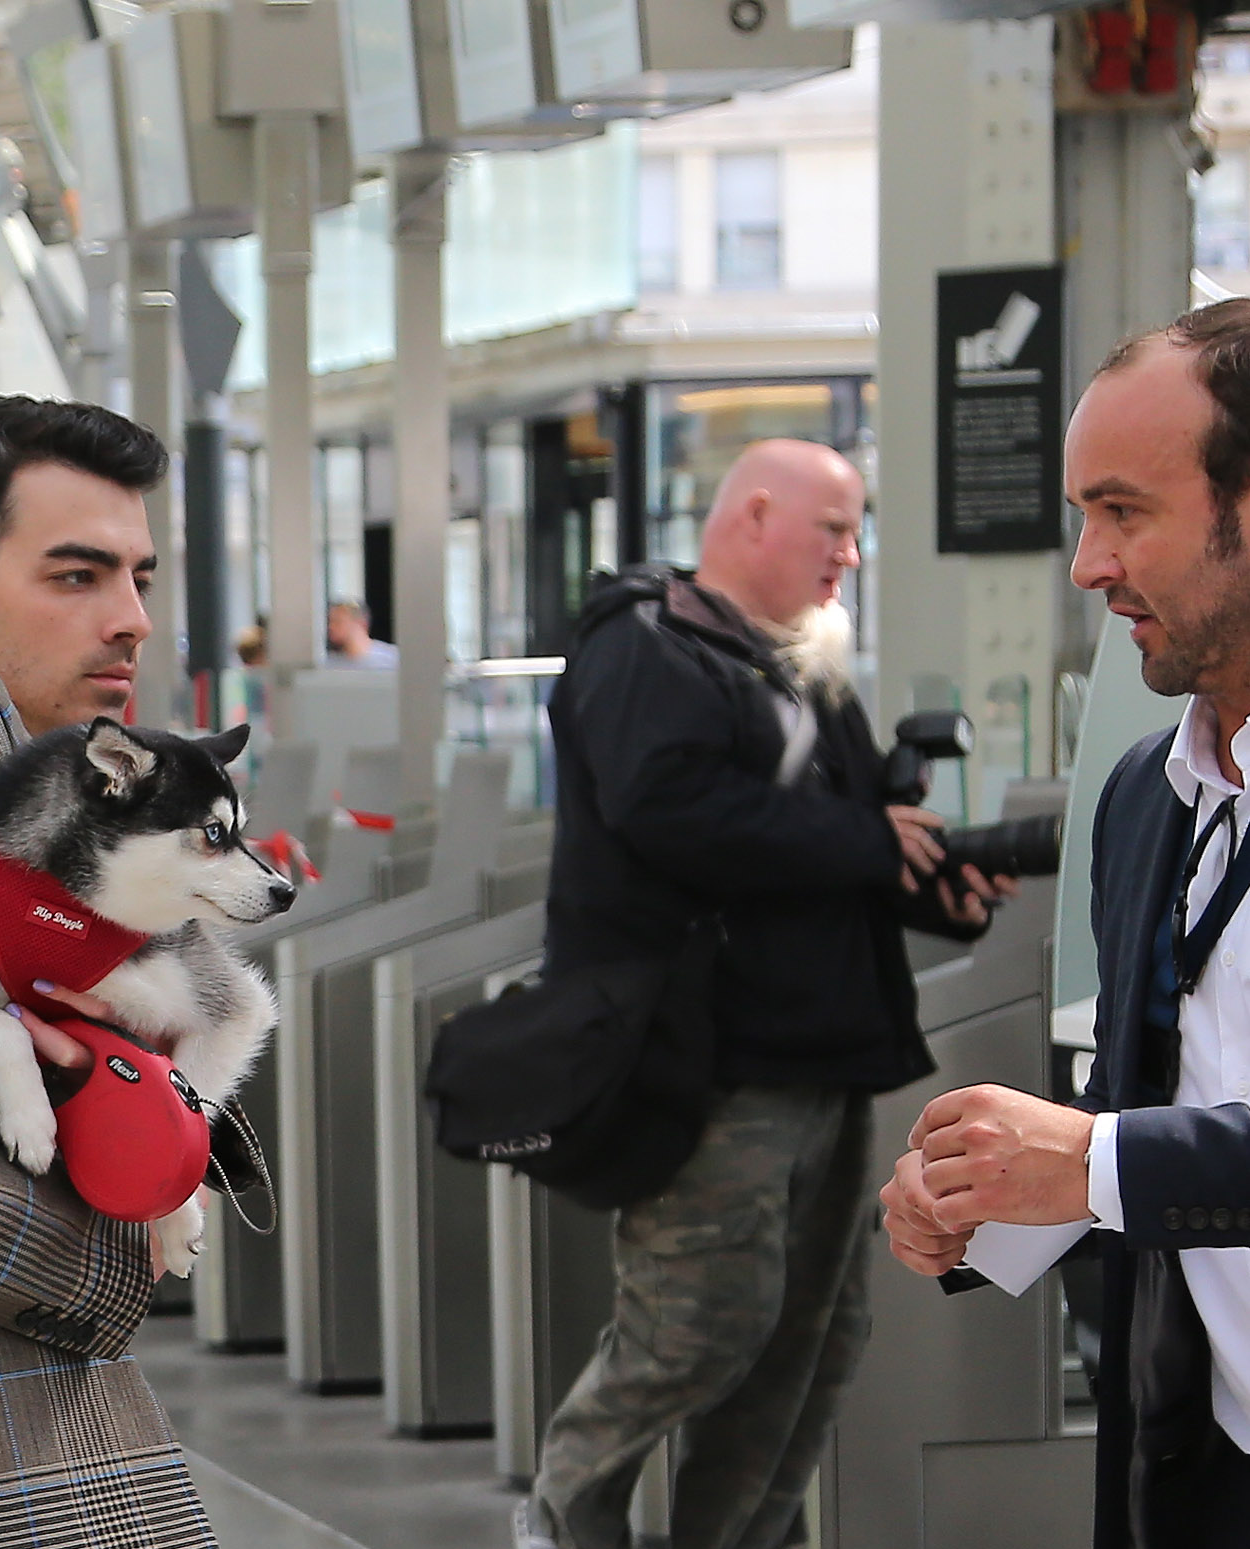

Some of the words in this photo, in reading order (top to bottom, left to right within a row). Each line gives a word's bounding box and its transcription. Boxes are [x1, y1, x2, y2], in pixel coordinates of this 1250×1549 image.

[53, 911, 85, 931] Doggie
[109, 1057, 139, 1081] flexi
[481, 1132, 552, 1158] PRESS
